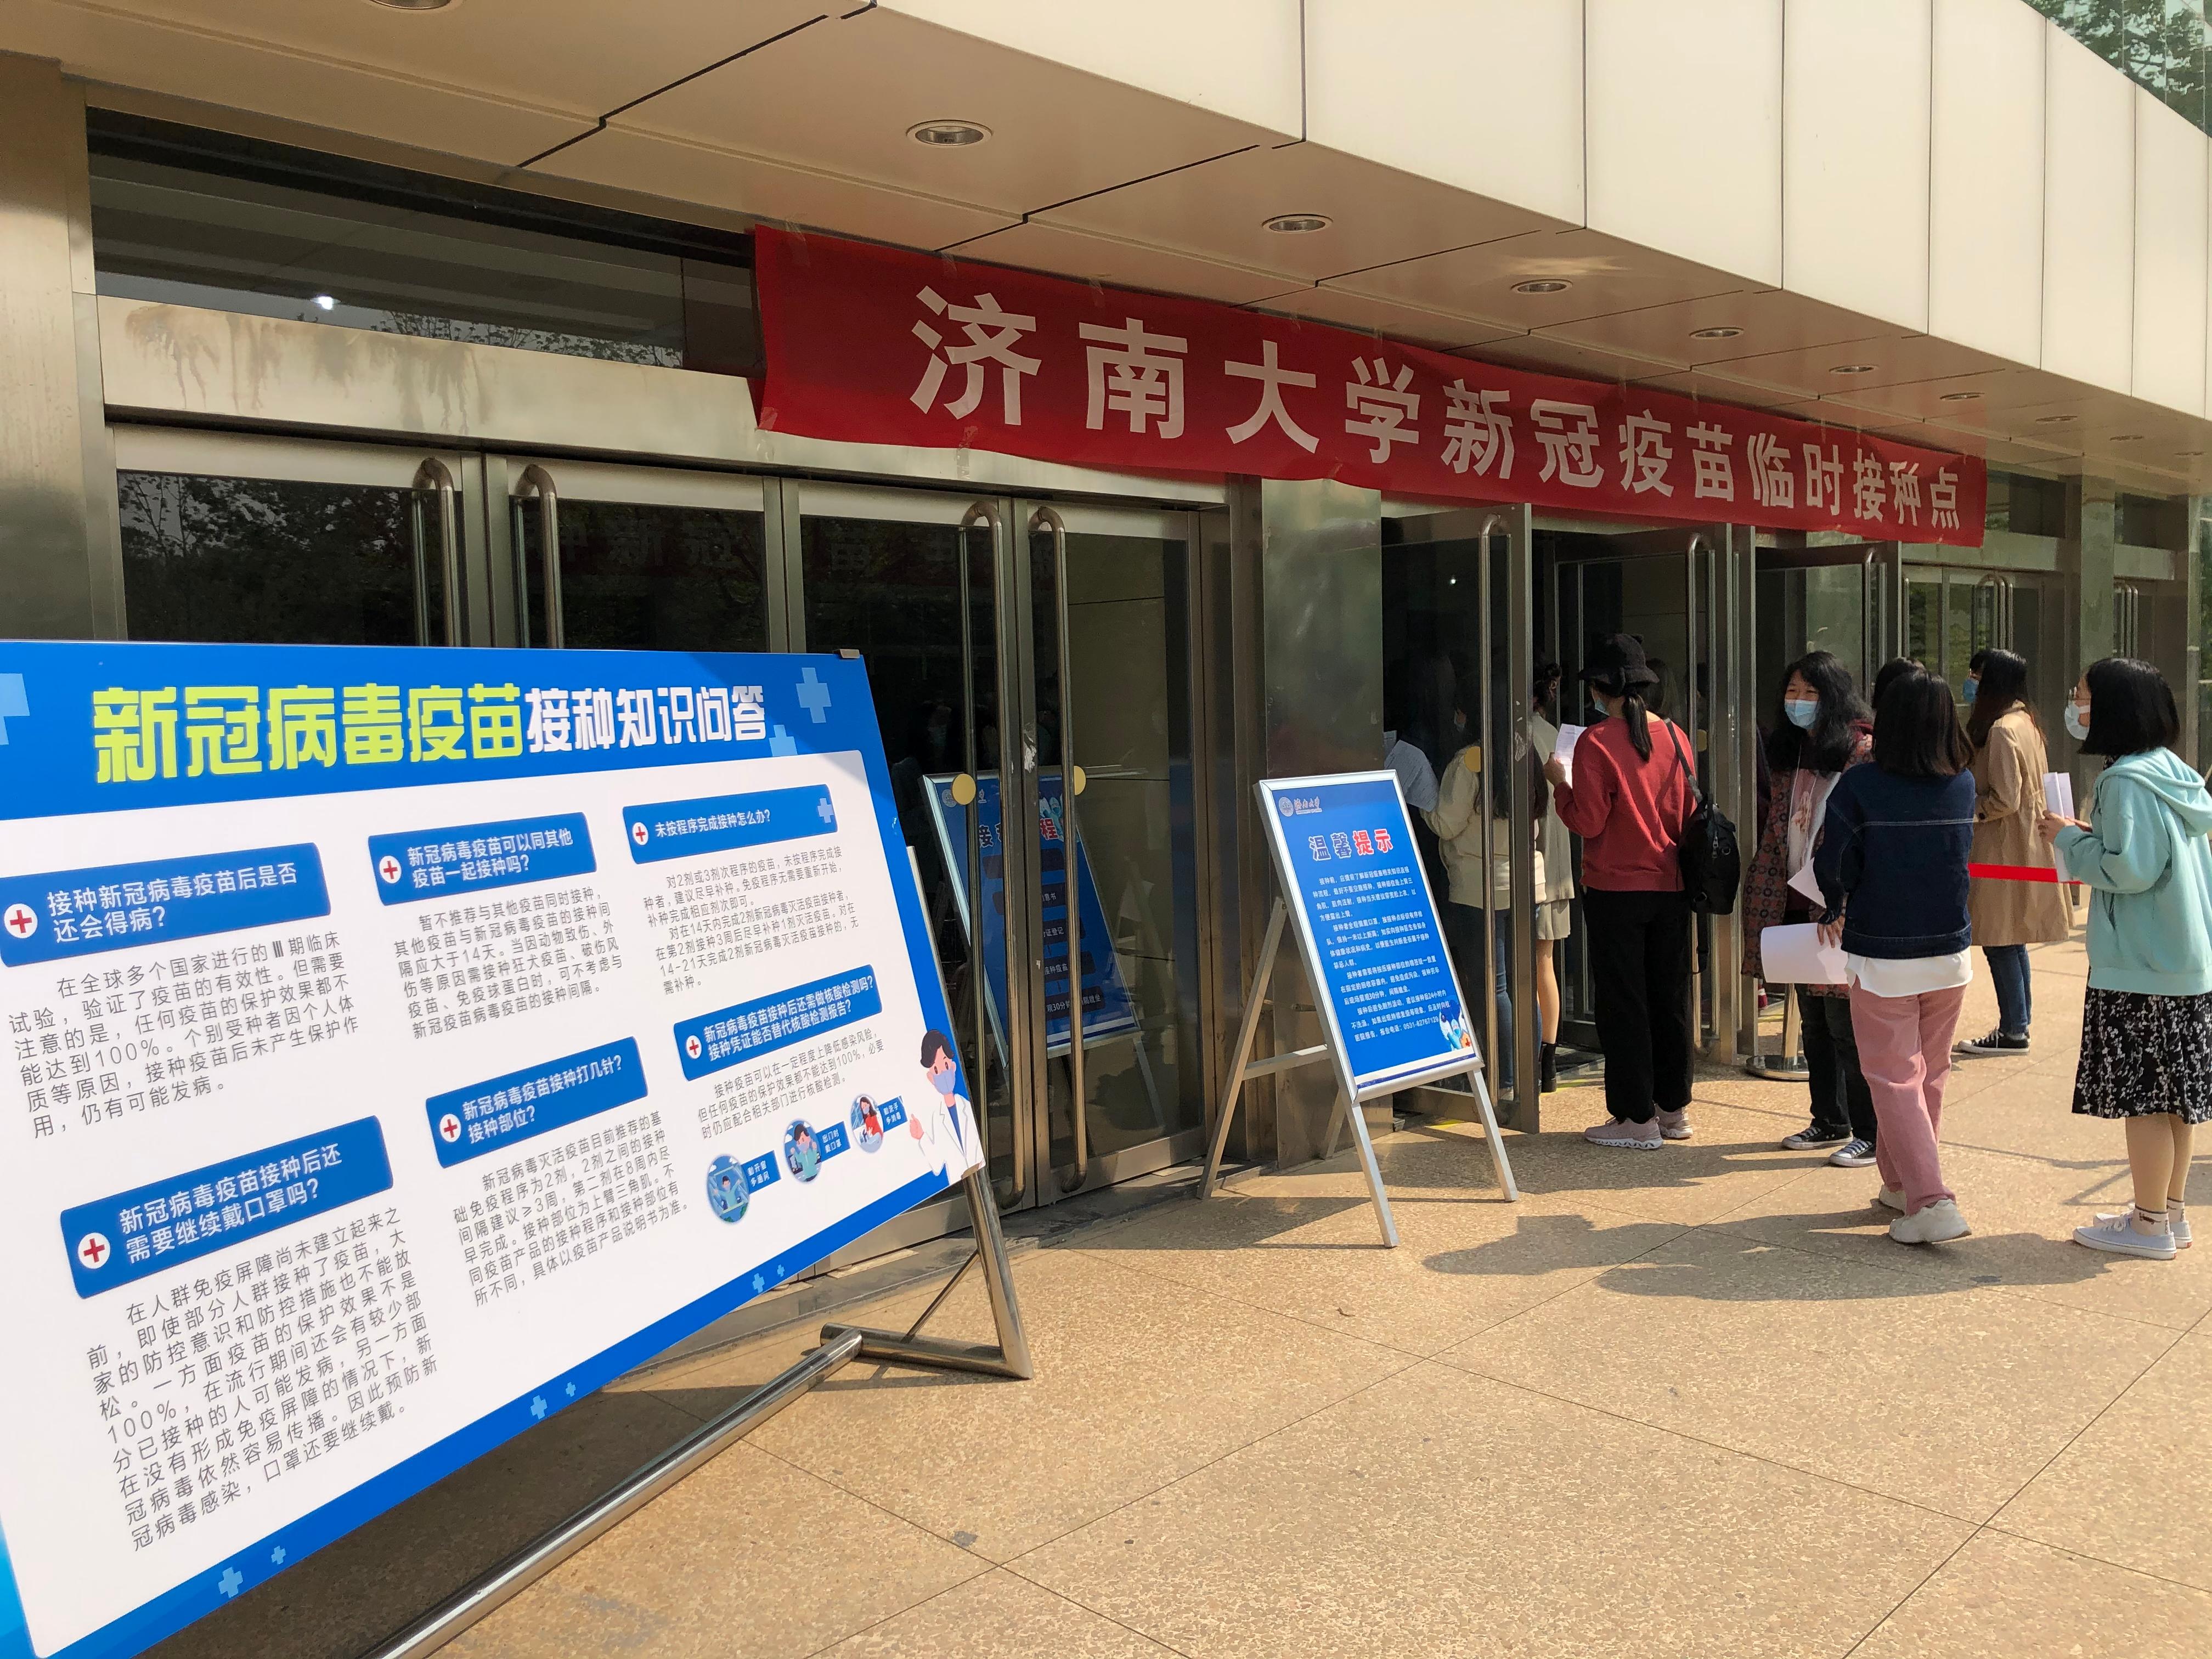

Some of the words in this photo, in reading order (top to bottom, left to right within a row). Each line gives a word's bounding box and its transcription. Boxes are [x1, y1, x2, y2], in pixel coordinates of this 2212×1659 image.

[910, 285, 1960, 531] 济南大学新冠疫苗临时接种点
[92, 682, 766, 784] 新冠病毒疫苗接种知识问答
[407, 828, 573, 867] 新冠病毒疫苗可以同其他
[1308, 828, 1394, 861] 温馨提示
[47, 862, 297, 917] 接种新冠病毒疫苗后是否
[53, 905, 166, 944] 还会得病?
[394, 902, 611, 958] 其他疫苗与新冠病毒疫苗的接种间
[419, 886, 601, 932] 暂不推荐与其他疫苗同时接种,
[647, 894, 754, 928] 补种完成相应剂次即可。
[398, 919, 614, 979] 隔应大于14天。当因动物致伤、外
[403, 936, 619, 998] 伤等原因需接种狂犬疫苗、破伤风
[663, 973, 702, 995] 需补种。
[9, 953, 345, 1035] 试验,验证了疫苗的有效性。但需要
[14, 973, 349, 1060] 注意的是,任何疫苗的保护效果都不
[412, 980, 600, 1040] 新冠疫苗病毒疫苗的接种间隔。
[27, 1015, 359, 1113] 质等原因,接种疫苗后未产生保护作
[462, 1054, 623, 1122] 新冠病毒疫苗接种打几针?
[34, 1075, 225, 1139] 用,仍有可能发病。
[467, 1105, 536, 1144] 接种部位?
[120, 1144, 343, 1235] 新冠病毒疫苗接种后还
[482, 1110, 662, 1192] 新冠病毒灭活疫苗目前推荐的基
[126, 1178, 319, 1264] 需要继续戴口罩吗?
[469, 1181, 680, 1286] 同疫苗产品的接种程序和接种部位有
[86, 1229, 406, 1370] 前,即使部分人群接种了疫苗,大
[126, 1207, 402, 1326] 在人群免疫屏障尚未建立起来之
[93, 1249, 411, 1396] 家的防控意识和防控措施也不能放
[100, 1272, 417, 1421] 松。一方面疫苗的保护效果不是
[113, 1314, 427, 1474] 分已接种的人可能发病,另一方面
[119, 1336, 432, 1499] 在没有形成免疫屏障的情况下,新
[124, 1357, 438, 1526] 冠病毒依然容易传播。因此预防新
[131, 1401, 407, 1553] 冠病毒感染,口罩还要继续戴。
